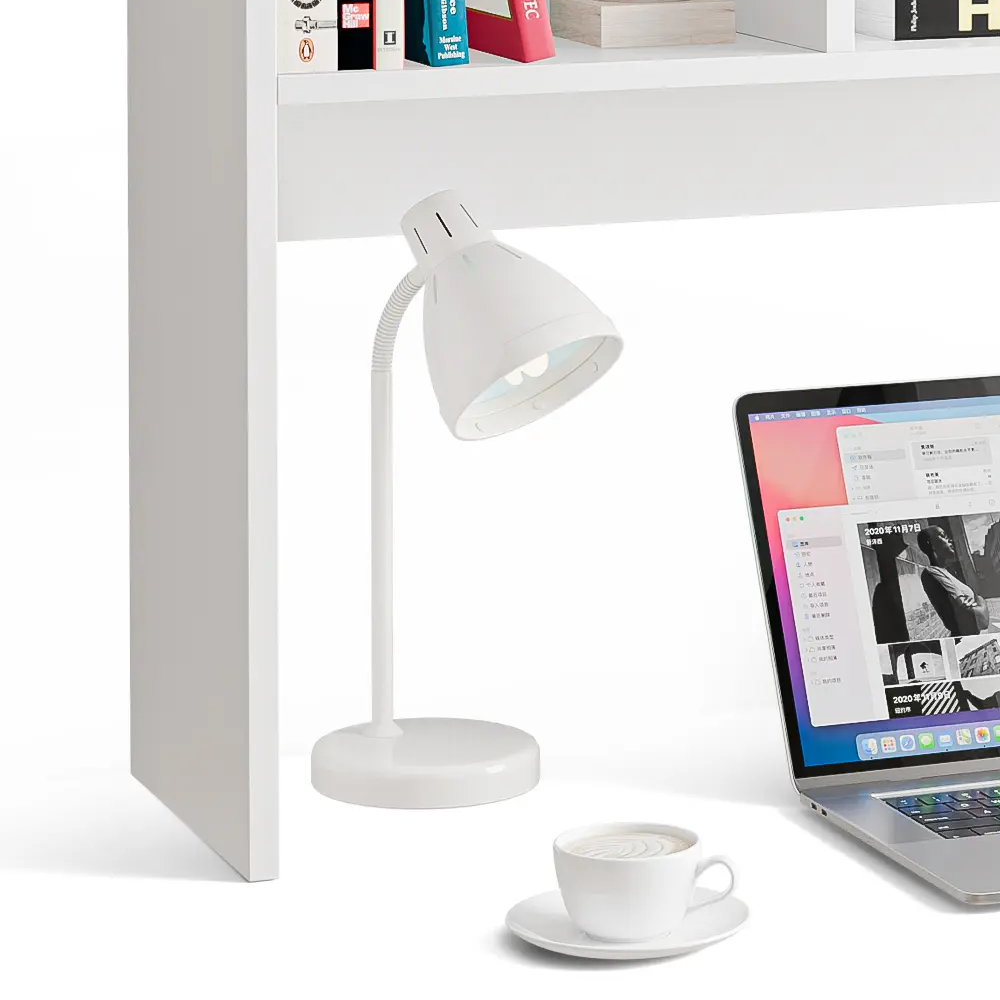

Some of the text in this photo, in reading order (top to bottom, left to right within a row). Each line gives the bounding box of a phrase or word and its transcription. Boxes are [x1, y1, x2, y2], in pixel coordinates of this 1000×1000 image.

[437, 51, 465, 60] Publishing
[864, 523, 921, 536] 2020年11月7日
